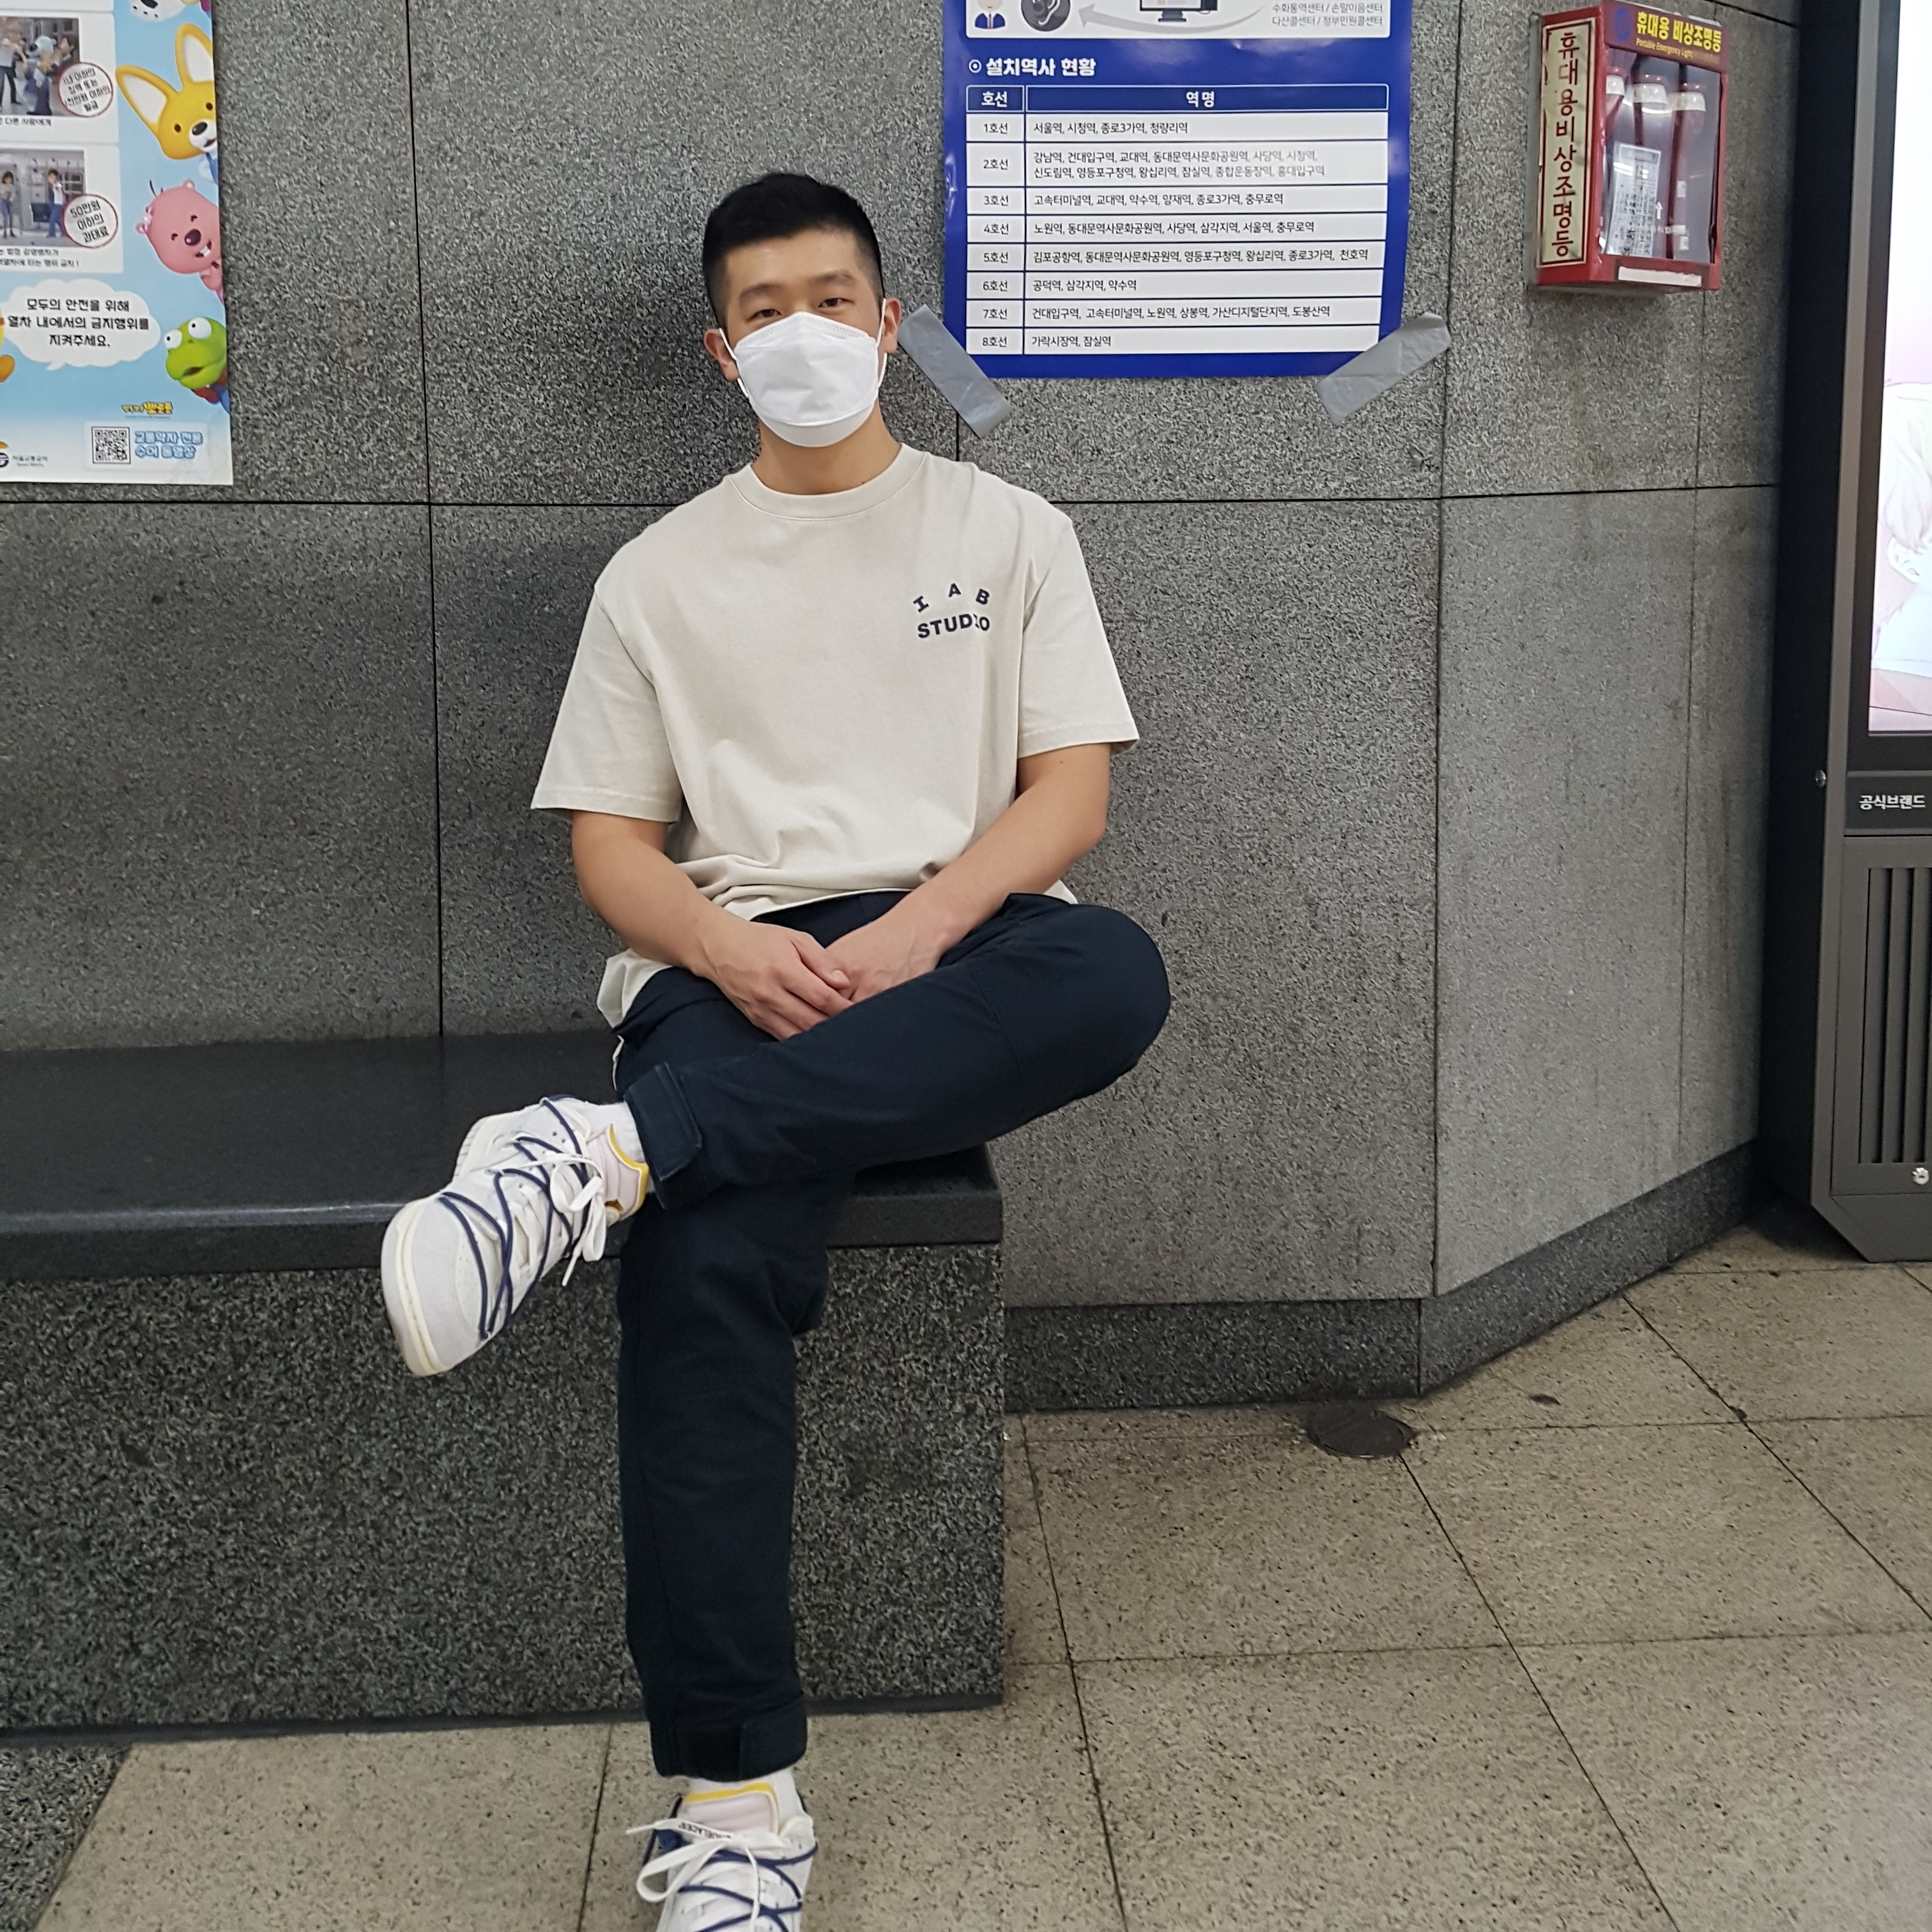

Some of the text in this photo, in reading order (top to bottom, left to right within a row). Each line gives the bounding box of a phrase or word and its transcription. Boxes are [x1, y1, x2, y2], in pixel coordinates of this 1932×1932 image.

[1636, 11, 1722, 53] 휴대용 비상조명등
[986, 57, 1096, 77] 설치역사 현황
[981, 91, 1008, 107] 호선
[983, 122, 1008, 135] 1호선
[1033, 122, 1188, 135] 서울역, 시청역, 종로3가역, 청량리역
[1551, 32, 1580, 257] 휴대용비상조명등
[1033, 150, 1318, 164] 강남역, 건대입구역, 교대역, 동대문역사문화공원역, 사당역, 시청역,
[983, 158, 1009, 171] 2호선
[983, 195, 1009, 207] 3호선
[1034, 194, 1284, 207] 고속터미널역, 교대역, 약수역, 양재역, 종로3가역, 충무로역
[70, 199, 101, 218] 50만원
[77, 212, 104, 231] 이하의
[983, 222, 1009, 236] 4호선
[1033, 222, 1315, 236] 노원역, 동대문역사문화공원역, 사당역, 삼각지역, 서울역, 충무로역
[983, 251, 1009, 264] 5호선
[1032, 249, 1368, 264] 김포공항역, 동대문역사문화공원역, 영등포구청역, 왕십리역, 종로3가역, 천호역
[983, 279, 1008, 293] 6호선
[1032, 279, 1137, 292] 공덕역, 삼각지역, 약수역
[27, 298, 130, 312] 모두의 안전을 위해
[982, 307, 1008, 320] 7호선
[1032, 306, 1331, 320] 건대입구역, 고속터미널역, 노원역, 상봉역, 가산디지털단지역, 도봉산역
[8, 316, 150, 329] 열차 내에서의 금지행위를
[49, 334, 111, 348] 지켜주세요.
[982, 336, 1008, 348] 8호선
[1031, 335, 1112, 348] 가락시장역, 잠실역
[1859, 794, 1926, 810] 공식브랜드
